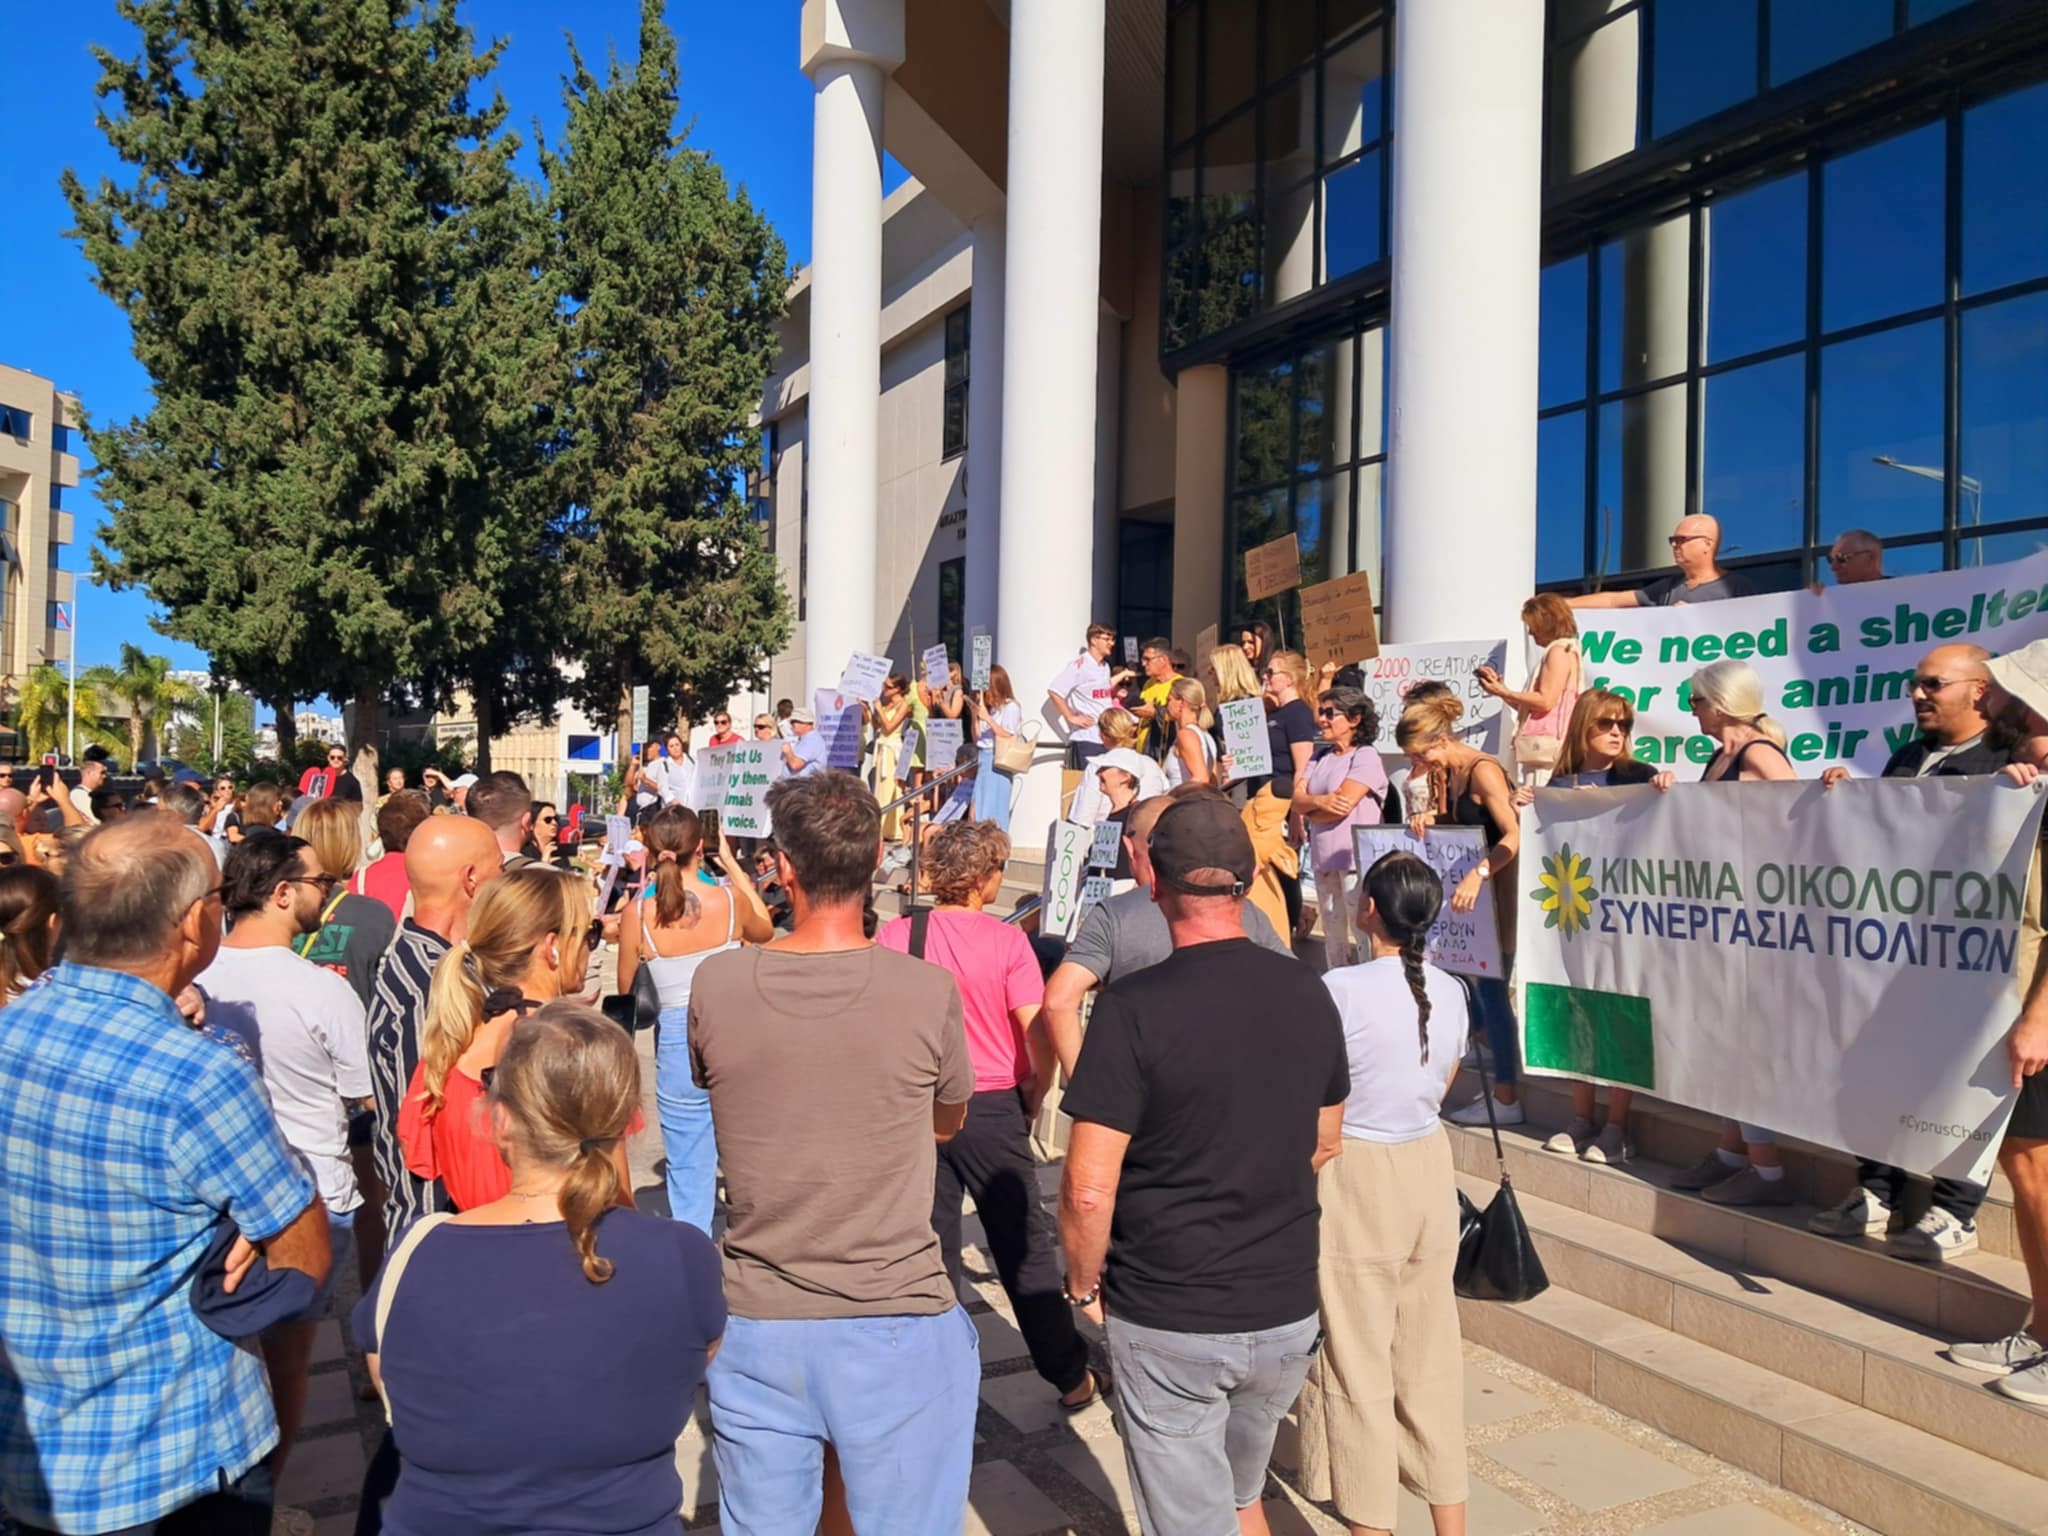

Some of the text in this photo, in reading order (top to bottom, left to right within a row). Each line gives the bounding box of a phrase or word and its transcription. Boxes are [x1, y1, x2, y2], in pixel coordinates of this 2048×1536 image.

[1581, 584, 2048, 664] We need a shelter
[1373, 657, 1410, 678] 2000
[1782, 665, 1917, 708] anim
[1224, 704, 1253, 718] THEY
[1788, 722, 1869, 761] eir
[727, 814, 758, 829] voice.
[1601, 857, 2027, 920] ΚΙΝΗΜΑ ΟΙΚΟΛΟΓΩΝ
[1600, 898, 2018, 973] ΣΥΝΕΡΓΑΣΙΑ ΠΟΛΙΤΩΝ
[1899, 1114, 1993, 1142] #CyprusChan
